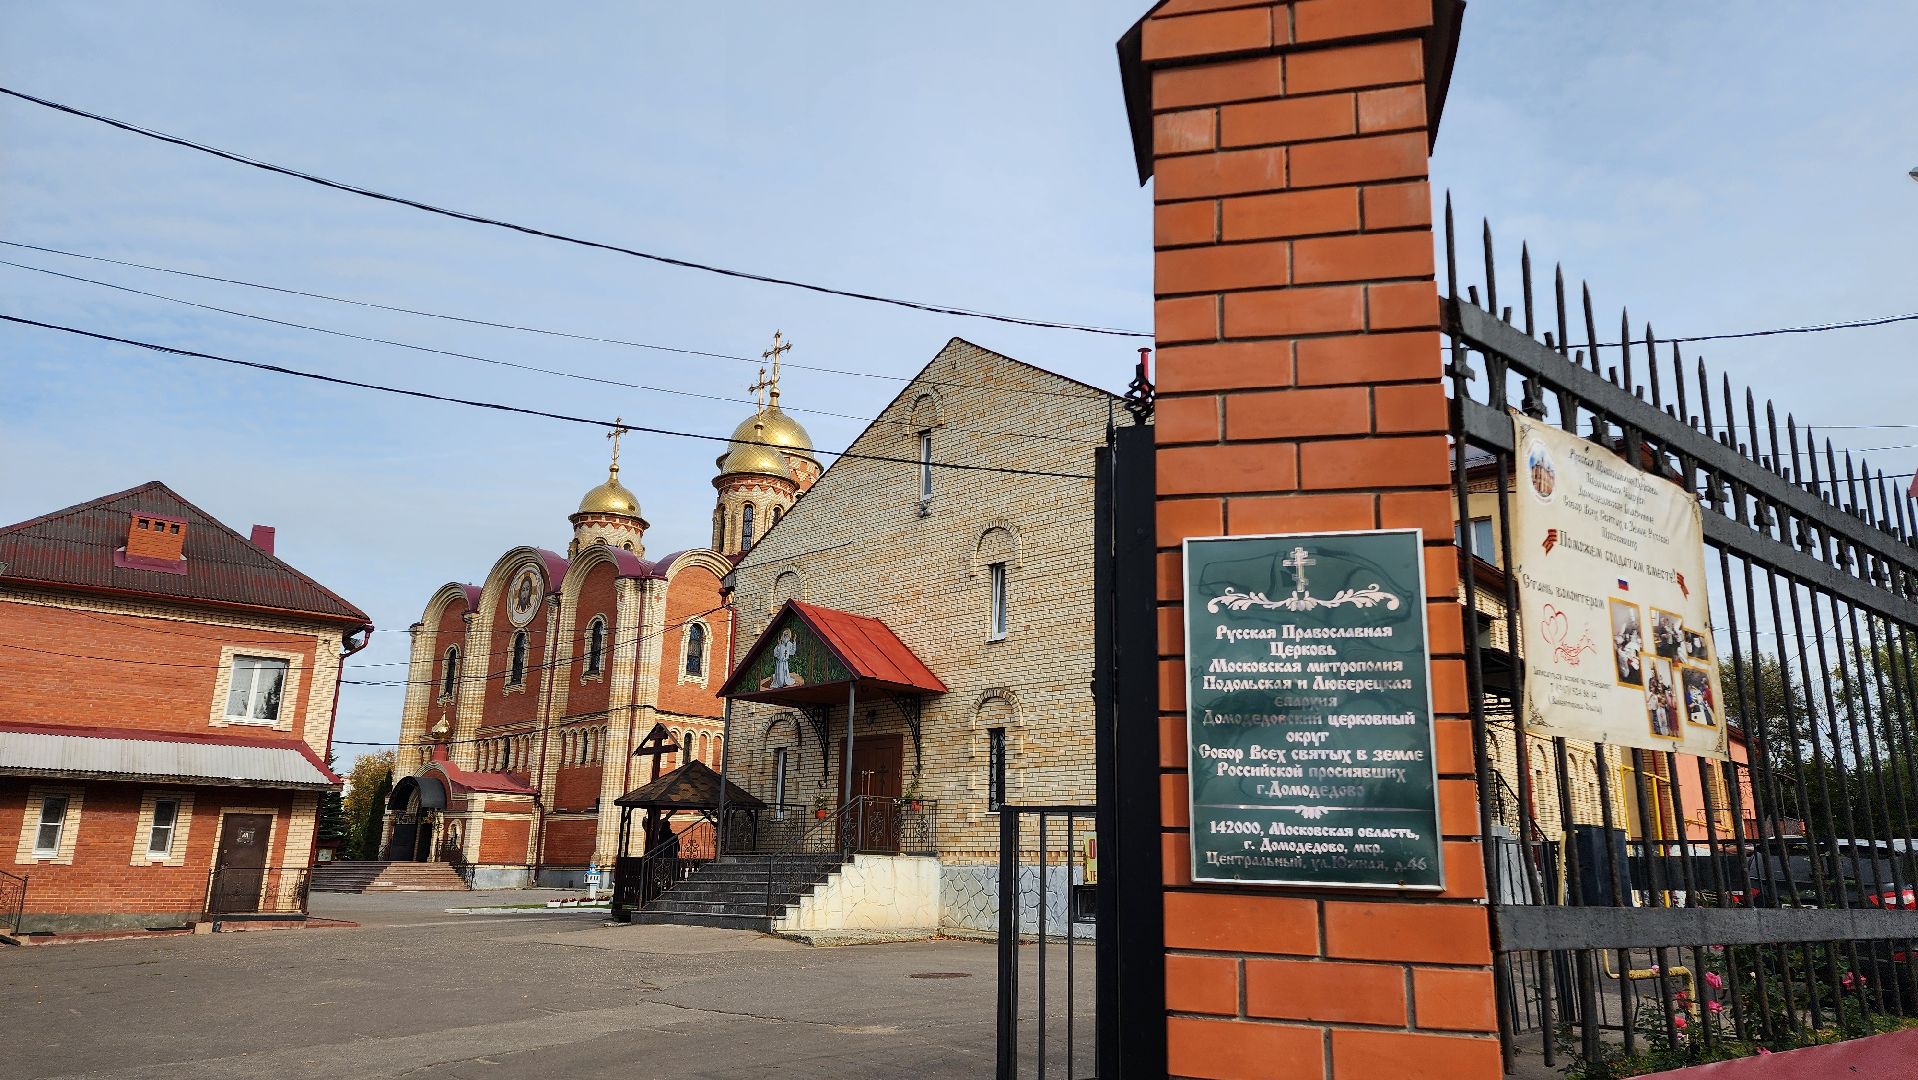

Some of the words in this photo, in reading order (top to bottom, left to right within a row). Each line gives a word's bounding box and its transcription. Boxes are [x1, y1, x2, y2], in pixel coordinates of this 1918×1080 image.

[1560, 530, 1602, 558] Поможем
[1605, 550, 1645, 573] солдатам
[1646, 564, 1676, 583] вместе!
[1522, 573, 1553, 595] Стань
[1216, 624, 1276, 643] Русская
[1281, 624, 1393, 642] Православная
[1270, 641, 1337, 659] Церковь
[1209, 658, 1301, 673] Московская
[1307, 660, 1403, 676] митрополия
[1202, 675, 1292, 692] Подольская
[1295, 678, 1308, 690] и
[1312, 676, 1412, 693] Люберецкая
[1274, 696, 1338, 713] епархия
[1203, 709, 1322, 727] Домодедовский
[1327, 711, 1416, 728] церковный
[1285, 731, 1330, 746] округ
[1199, 744, 1244, 762] Собор
[1249, 744, 1286, 763] Всех
[1291, 748, 1352, 764] святых
[1356, 750, 1368, 761] в
[1372, 749, 1424, 762] земле
[1216, 762, 1303, 778] Российской
[1308, 766, 1406, 782] просиявших
[1209, 820, 1264, 836] 142000,
[1268, 821, 1354, 837] Московская
[1357, 826, 1420, 841] область,
[1243, 840, 1255, 850] г.
[1260, 838, 1348, 855] Домодедово,
[1353, 842, 1385, 854] мкр.
[1393, 856, 1428, 872] д.46
